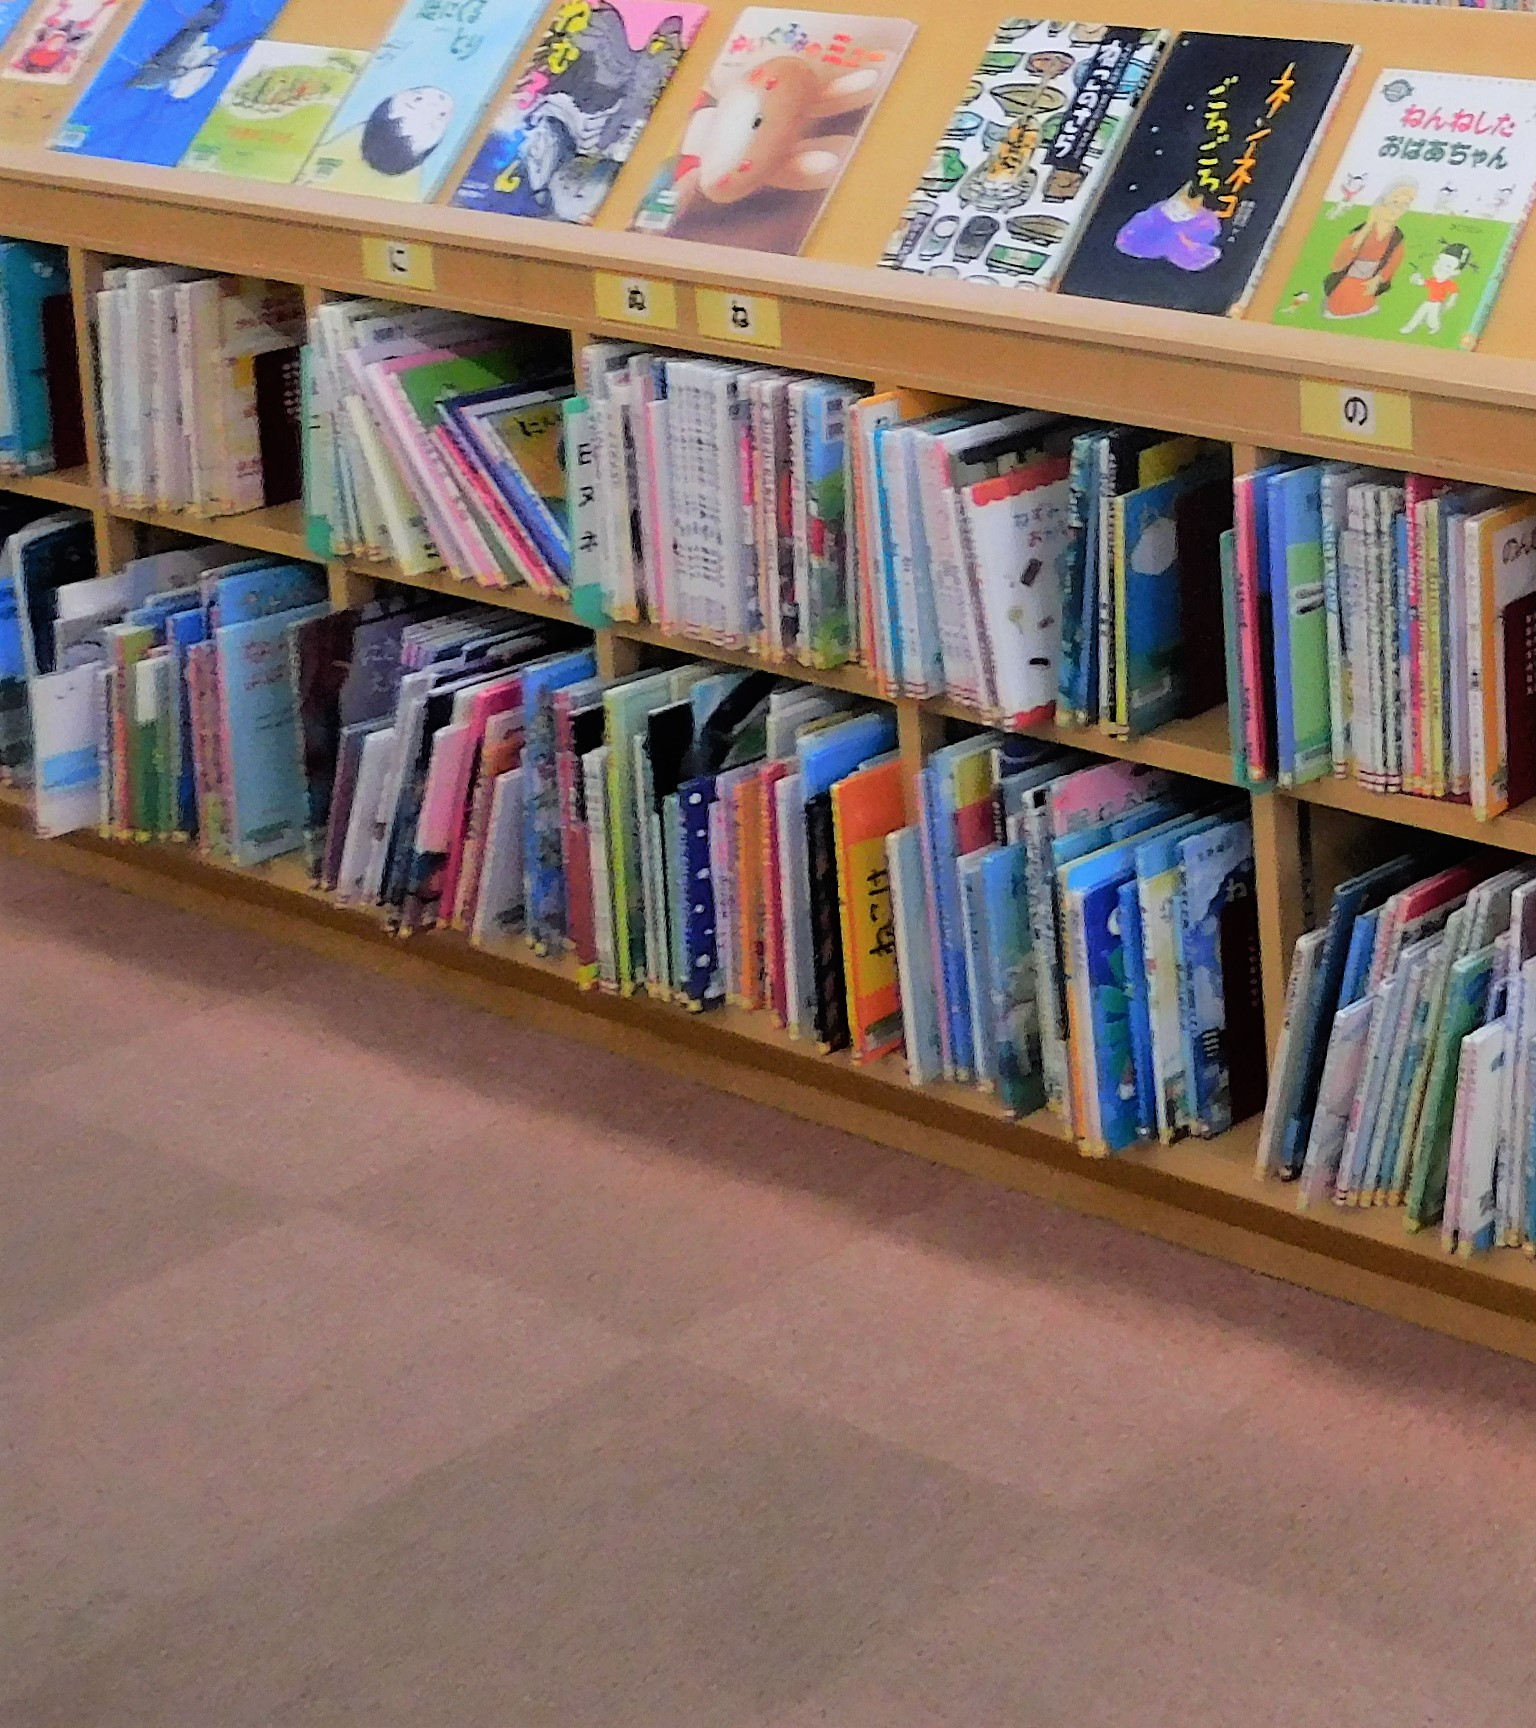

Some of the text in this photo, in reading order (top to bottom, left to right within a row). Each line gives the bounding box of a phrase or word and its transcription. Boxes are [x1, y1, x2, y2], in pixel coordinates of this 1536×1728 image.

[1401, 103, 1517, 138] ねんねした
[1378, 135, 1508, 170] おばあちゃん
[1344, 396, 1368, 426] の
